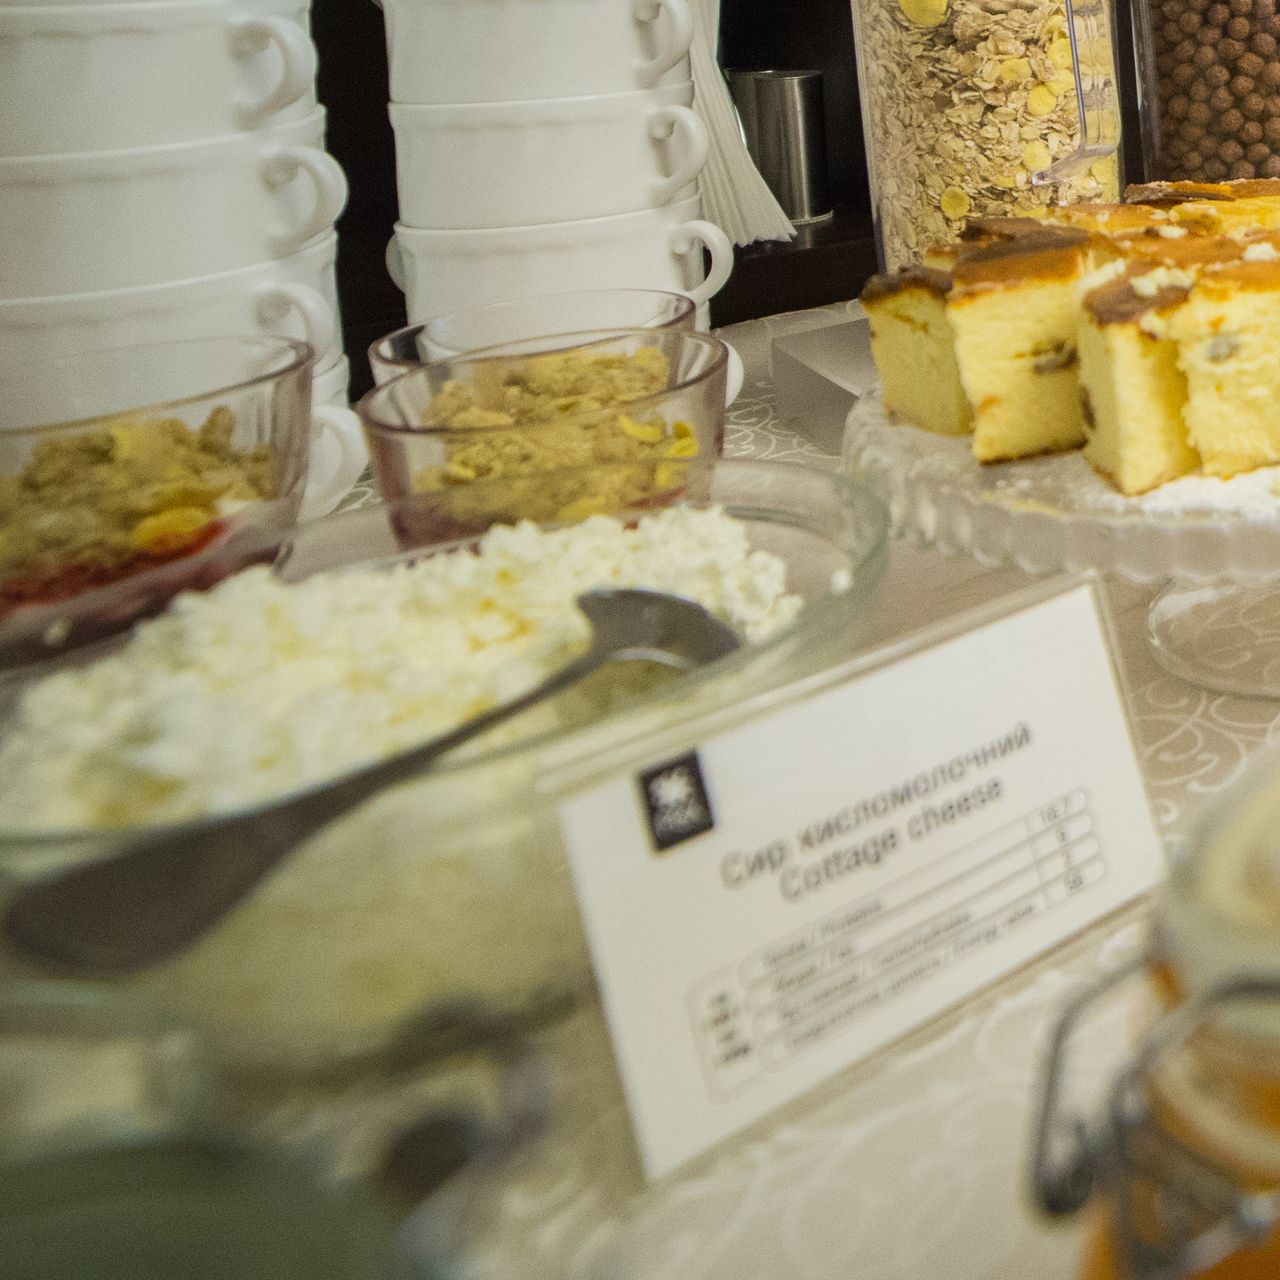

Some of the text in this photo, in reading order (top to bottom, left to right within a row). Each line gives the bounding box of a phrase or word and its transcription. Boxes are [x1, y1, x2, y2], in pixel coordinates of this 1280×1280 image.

[720, 837, 790, 890] Сир
[797, 720, 1033, 855] кисломолочний
[778, 776, 1005, 905] Cottage cheese
